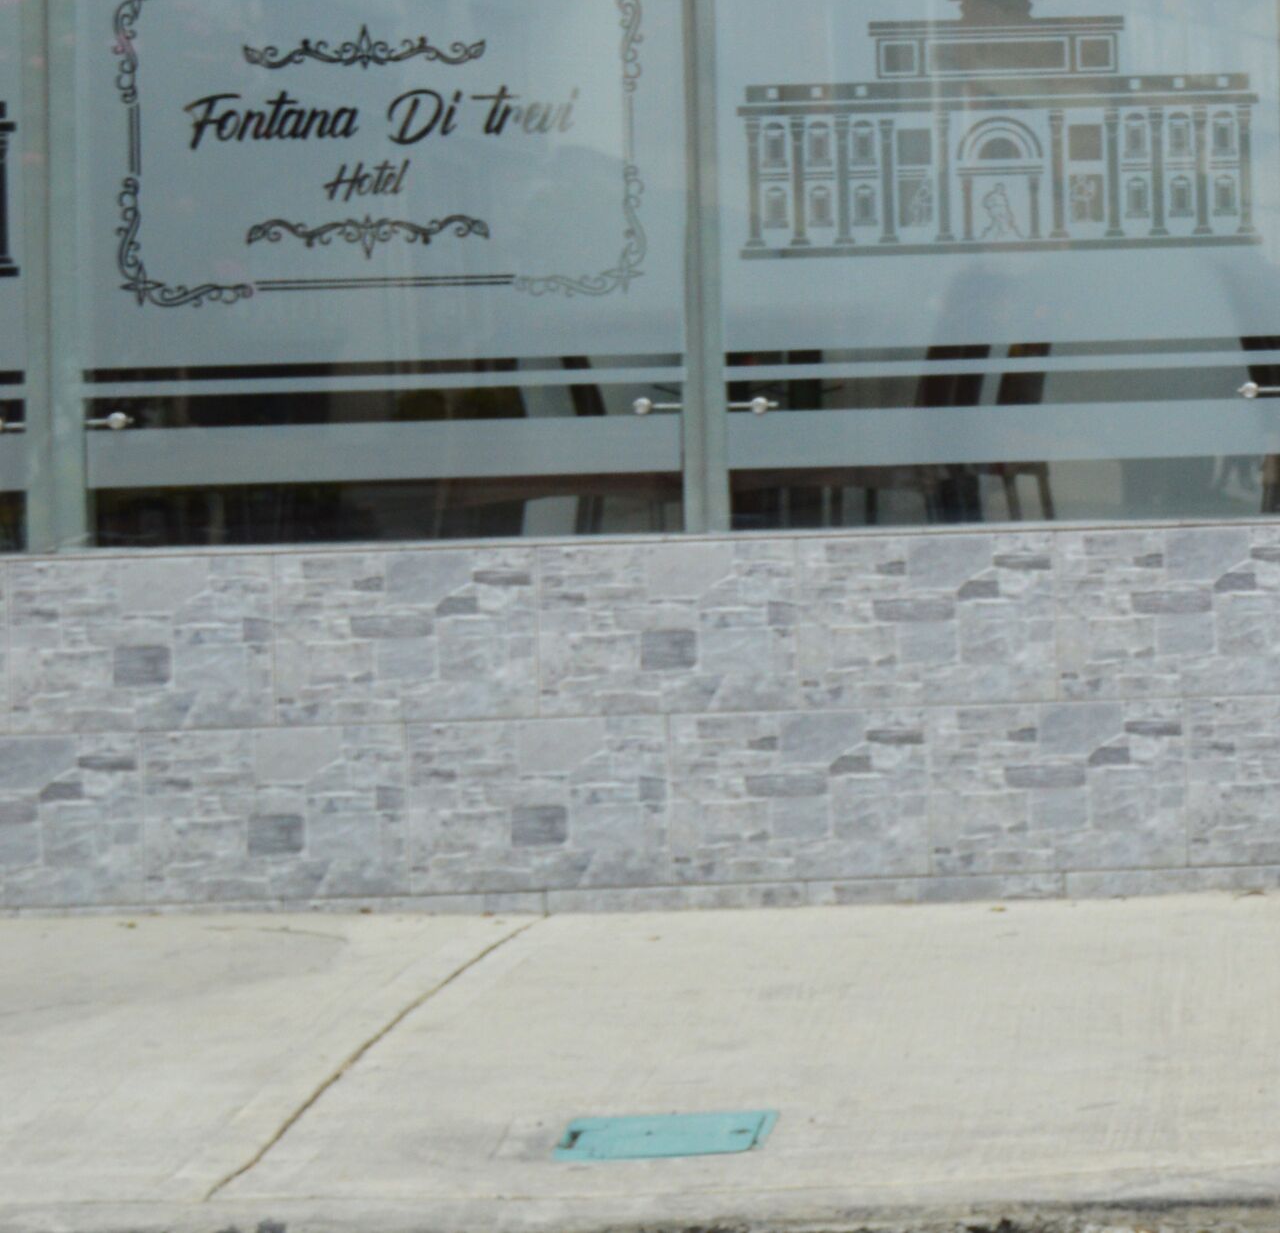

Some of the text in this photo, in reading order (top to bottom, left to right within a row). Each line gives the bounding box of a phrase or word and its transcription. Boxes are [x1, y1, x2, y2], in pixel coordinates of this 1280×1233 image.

[184, 90, 361, 150] Fontana
[387, 89, 462, 145] Di
[322, 159, 411, 202] Hotel
